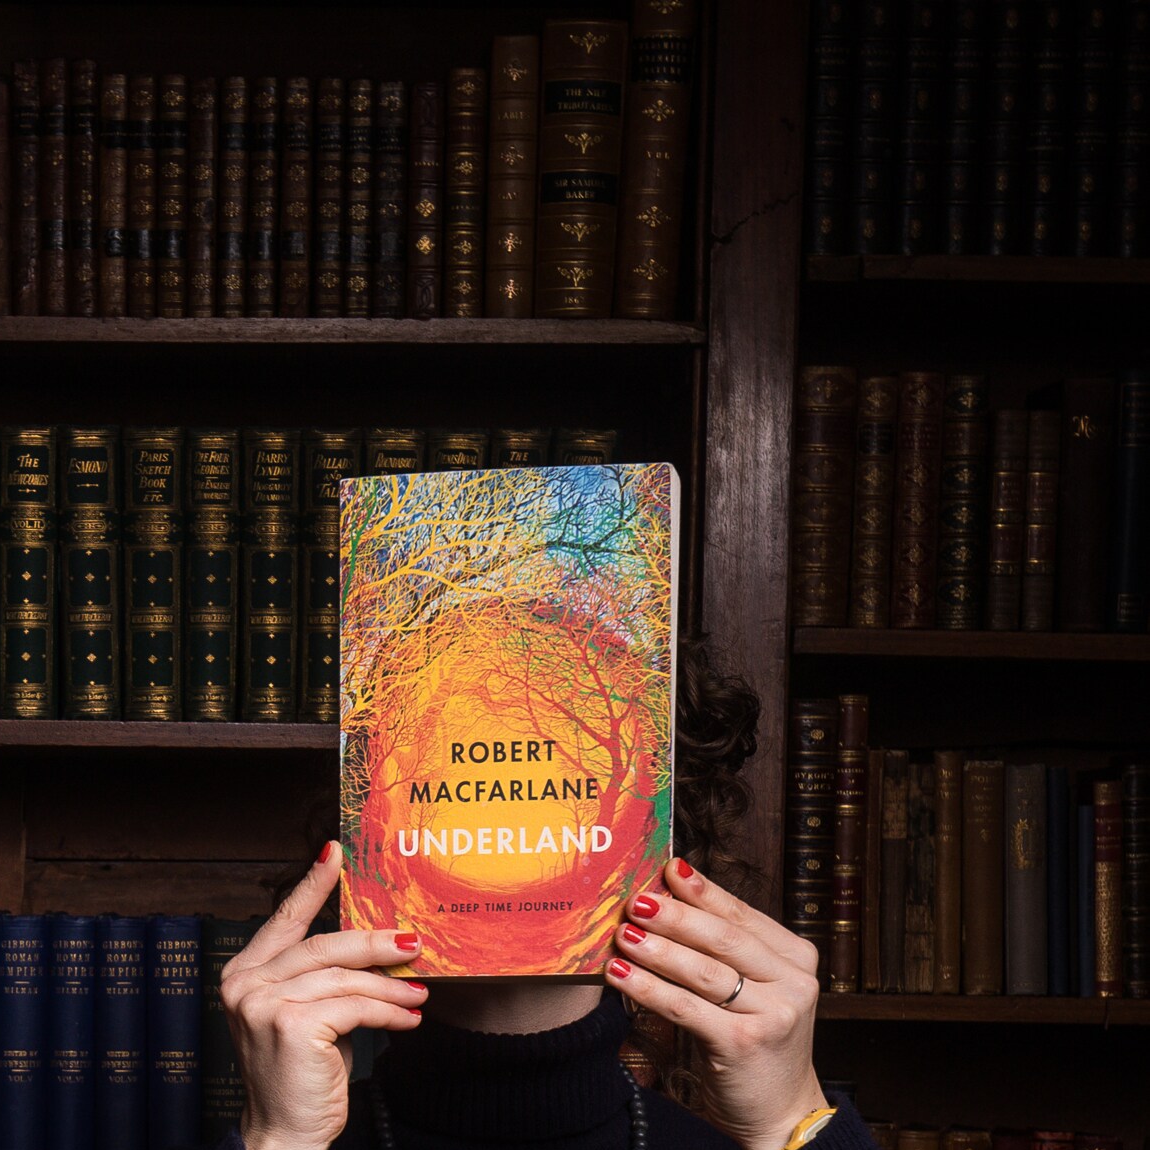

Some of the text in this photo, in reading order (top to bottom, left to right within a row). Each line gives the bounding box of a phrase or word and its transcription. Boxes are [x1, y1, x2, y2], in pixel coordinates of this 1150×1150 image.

[564, 88, 583, 97] THE
[17, 453, 40, 468] THE
[139, 450, 169, 463] PARIS
[256, 451, 289, 464] BARRY
[313, 453, 354, 469] BALLADS
[509, 450, 528, 461] THE
[67, 457, 108, 474] ESMOND
[134, 463, 172, 475] SKETCH
[253, 465, 291, 478] LYNDON
[138, 476, 167, 489] BOOK
[451, 740, 556, 764] ROBERT
[409, 778, 598, 804] MACFARLANE
[399, 825, 613, 857] UNDERLAND
[437, 900, 573, 913] A DEEP TIME JOURNEY
[1, 939, 43, 949] GIBBON'S
[53, 940, 94, 950] GIBBON'S
[102, 940, 144, 950] GIBBON'S
[156, 940, 198, 950] GIBBON'S
[5, 953, 39, 962] ROMAN
[56, 953, 90, 962] ROMAN
[106, 953, 140, 962] ROMAN
[160, 953, 195, 962] ROMAN
[0, 966, 43, 977] EMPIRE
[51, 967, 95, 977] EMPIRE
[101, 967, 144, 977] EMPIRE
[154, 967, 199, 978] EMPIRE
